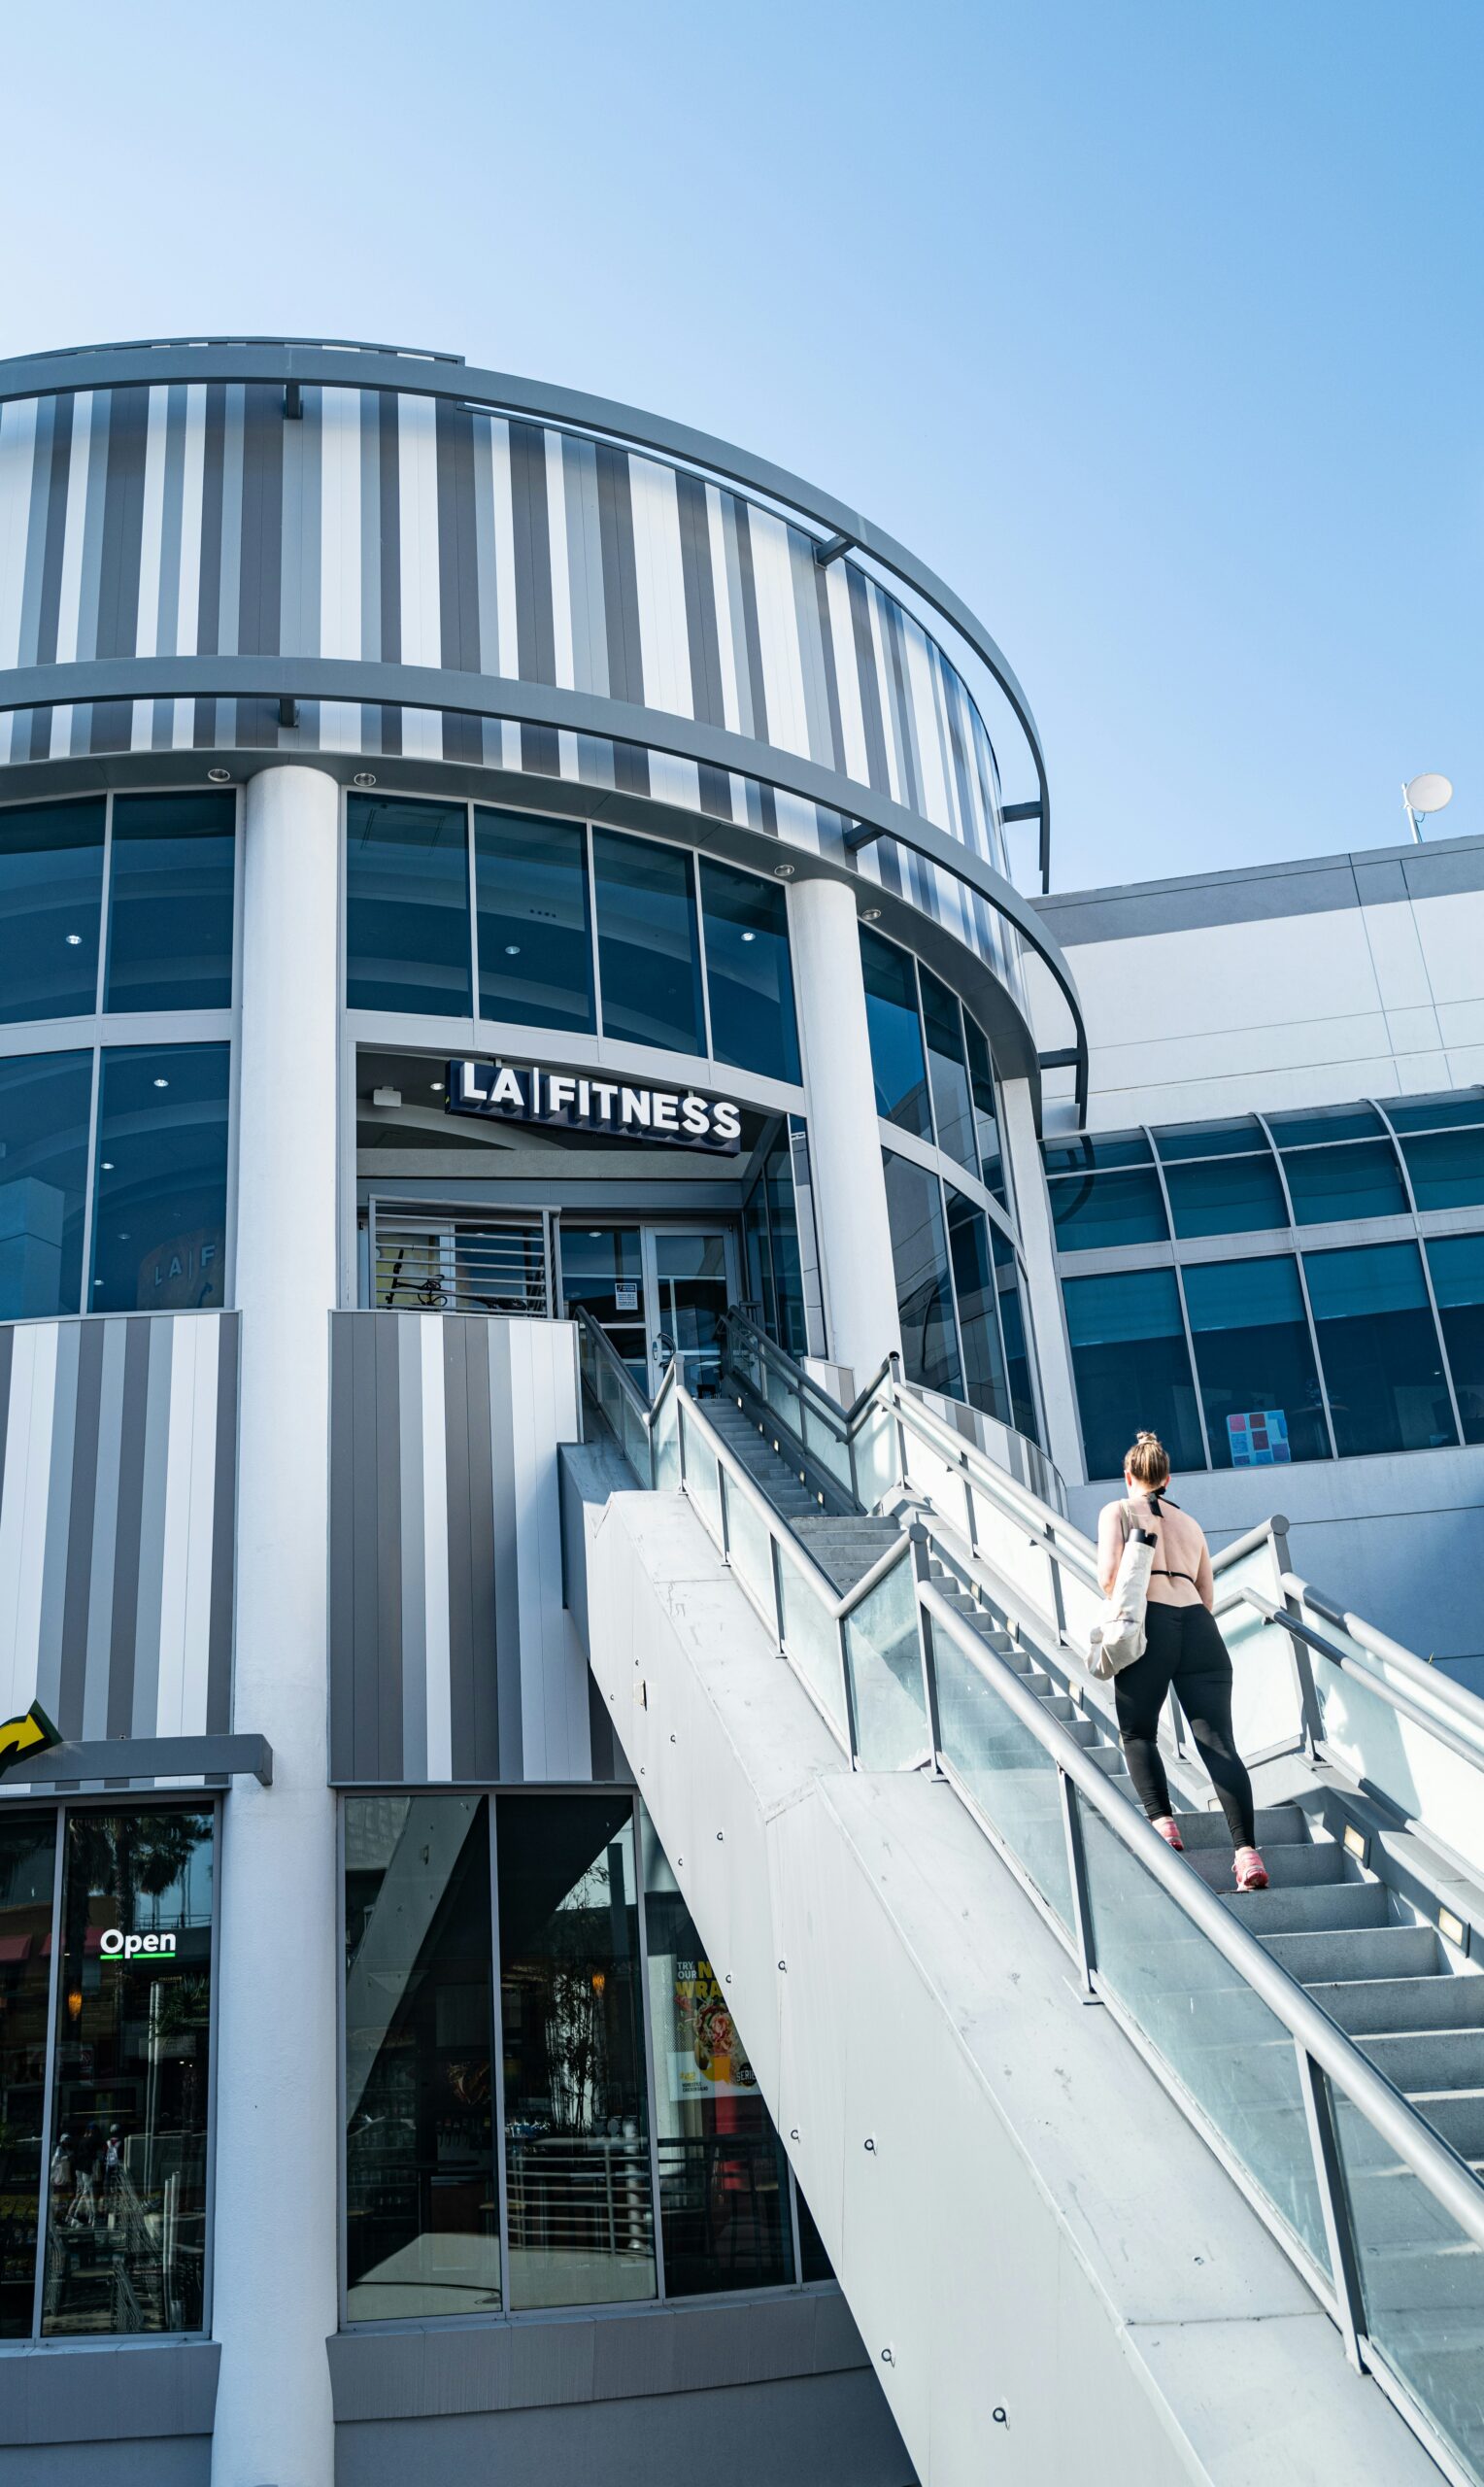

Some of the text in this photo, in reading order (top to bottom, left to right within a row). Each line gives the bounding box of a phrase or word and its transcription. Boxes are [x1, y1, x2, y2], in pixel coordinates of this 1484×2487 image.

[100, 1928, 177, 1959] Open
[677, 1961, 693, 1970] TRY
[678, 1970, 697, 1979] OUR
[675, 1980, 723, 1998] WRA
[736, 2069, 757, 2082] SERIE
